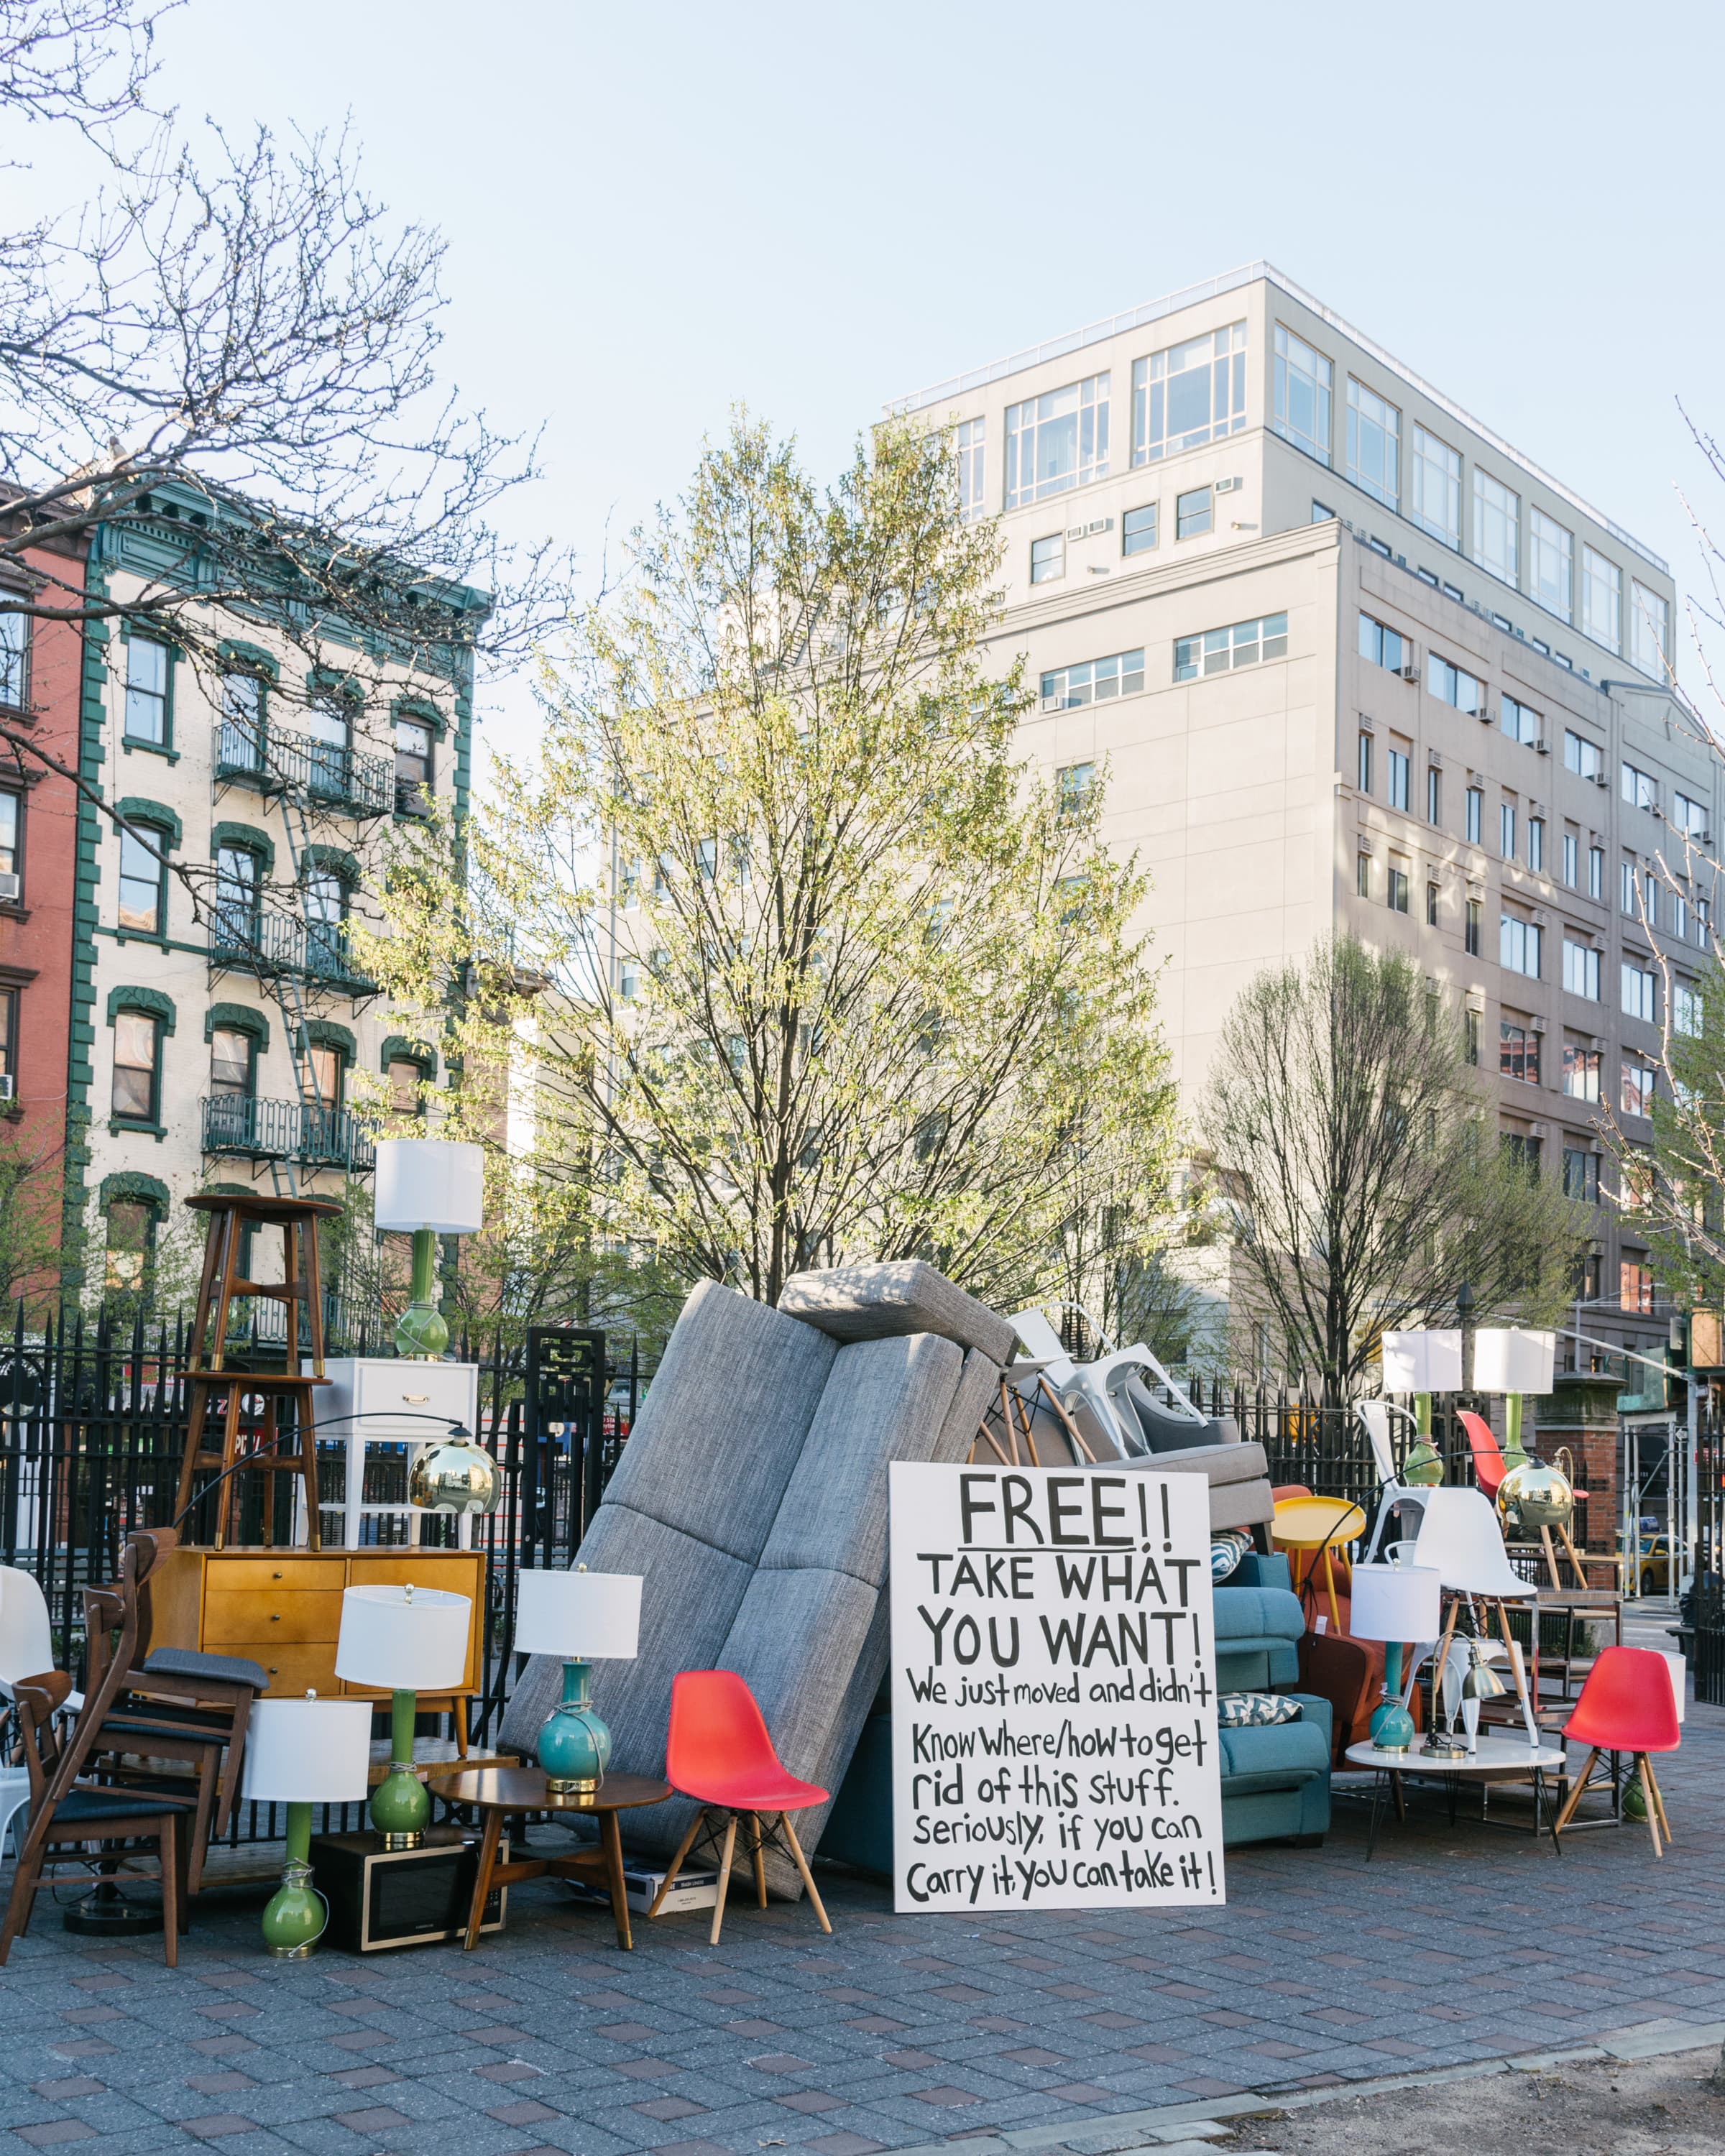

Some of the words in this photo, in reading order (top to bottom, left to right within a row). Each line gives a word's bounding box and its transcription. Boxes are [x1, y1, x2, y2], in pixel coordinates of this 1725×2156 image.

[960, 1474, 1172, 1553] FREE!!
[917, 1553, 1034, 1600] TAKE
[1056, 1555, 1200, 1607] WHAT
[917, 1605, 1019, 1667] YOU
[1039, 1612, 1201, 1668] WANT!
[906, 1666, 947, 1704] We
[955, 1673, 1010, 1708] just
[1014, 1672, 1080, 1705] moved
[1090, 1669, 1134, 1703] and
[1139, 1667, 1212, 1708] didn't
[1120, 1724, 1153, 1758] to
[1156, 1719, 1207, 1766] get
[913, 1763, 963, 1810] rid
[978, 1767, 1011, 1805] of
[1018, 1765, 1077, 1809] this
[1089, 1767, 1179, 1806] stuff.
[1058, 1812, 1083, 1850] if
[1094, 1816, 1143, 1851] you
[1151, 1815, 1202, 1839] can
[993, 1855, 1016, 1895] it,
[1015, 1859, 1067, 1901] you
[1073, 1862, 1118, 1888] can
[1119, 1850, 1174, 1892] take
[1179, 1851, 1216, 1894] it!
